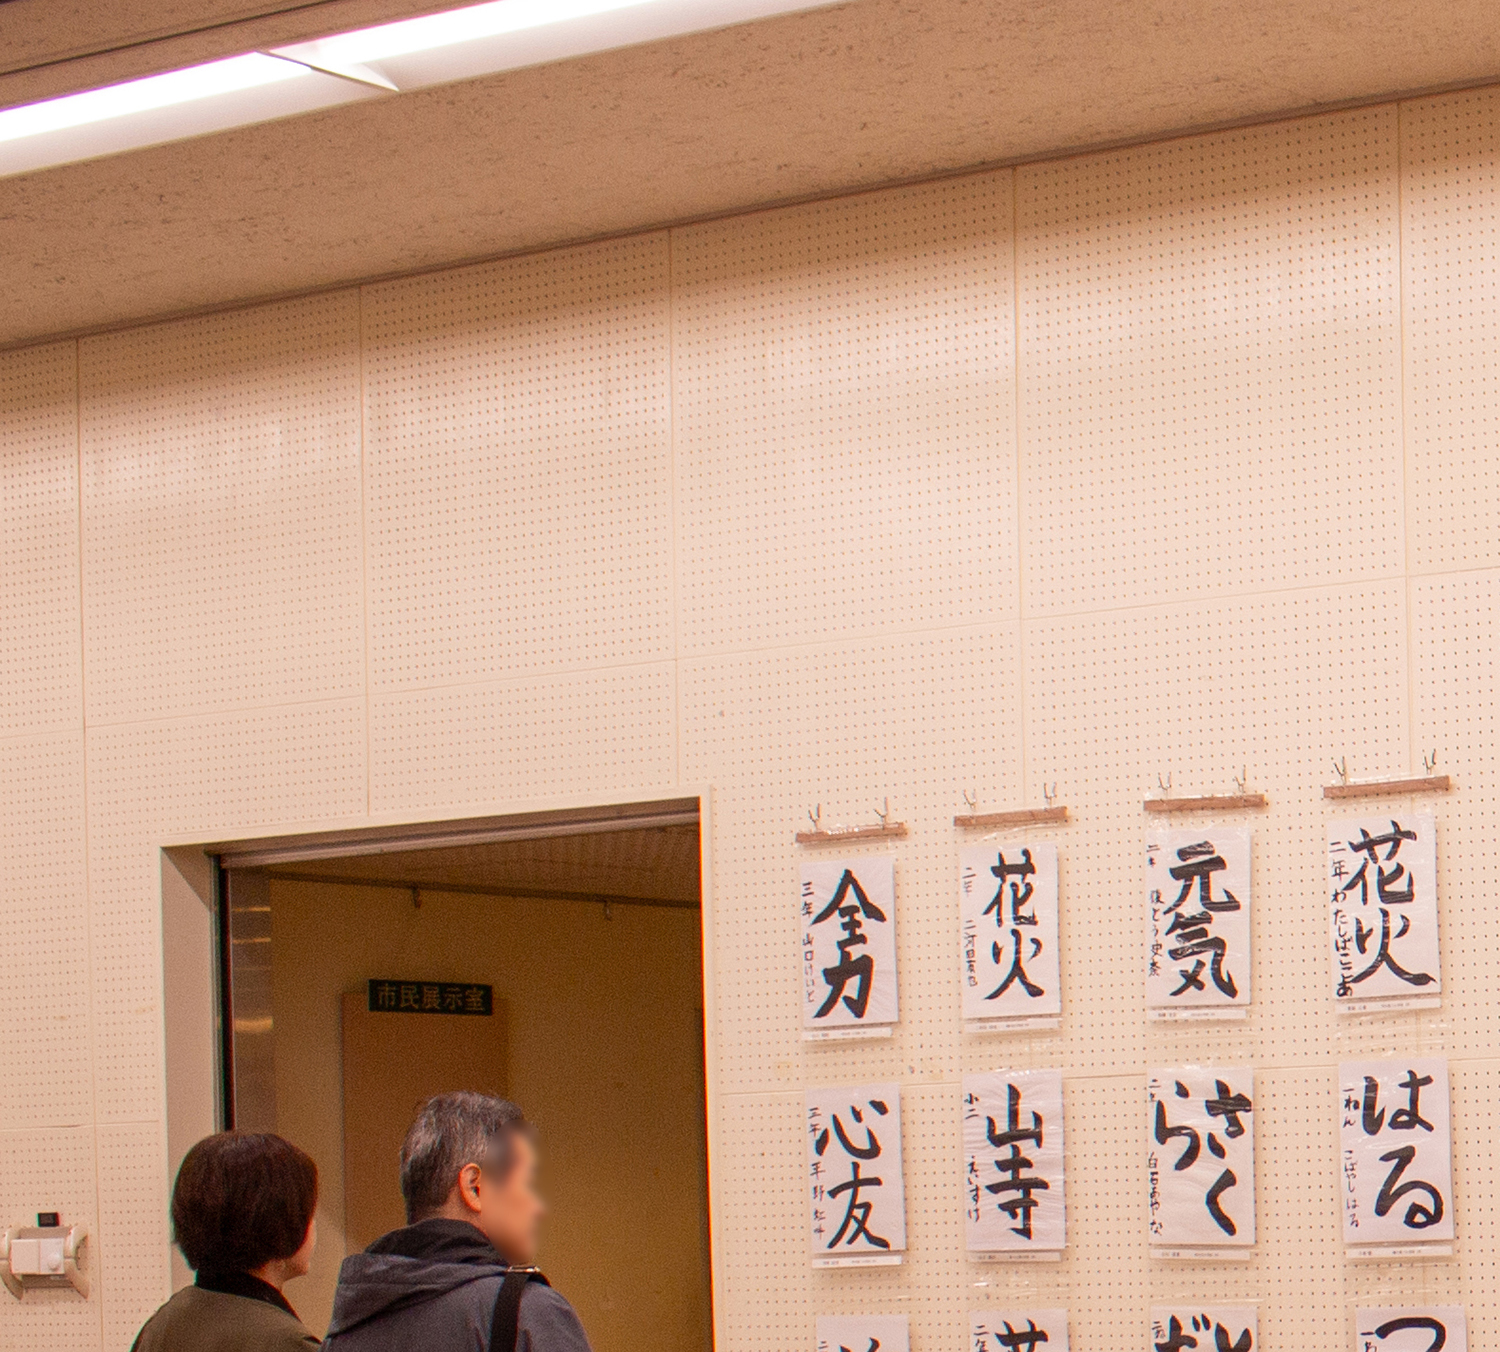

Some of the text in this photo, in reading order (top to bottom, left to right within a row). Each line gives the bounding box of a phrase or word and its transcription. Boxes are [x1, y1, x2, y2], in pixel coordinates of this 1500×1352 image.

[810, 868, 887, 1019] 全力
[983, 848, 1046, 1000] 花火
[1163, 840, 1241, 999] 元気
[1344, 819, 1438, 987] 花火
[377, 982, 486, 1011] 市民展示室
[815, 1099, 891, 1249] 心友
[985, 1083, 1050, 1240] 山寺
[1362, 1070, 1444, 1229] はる
